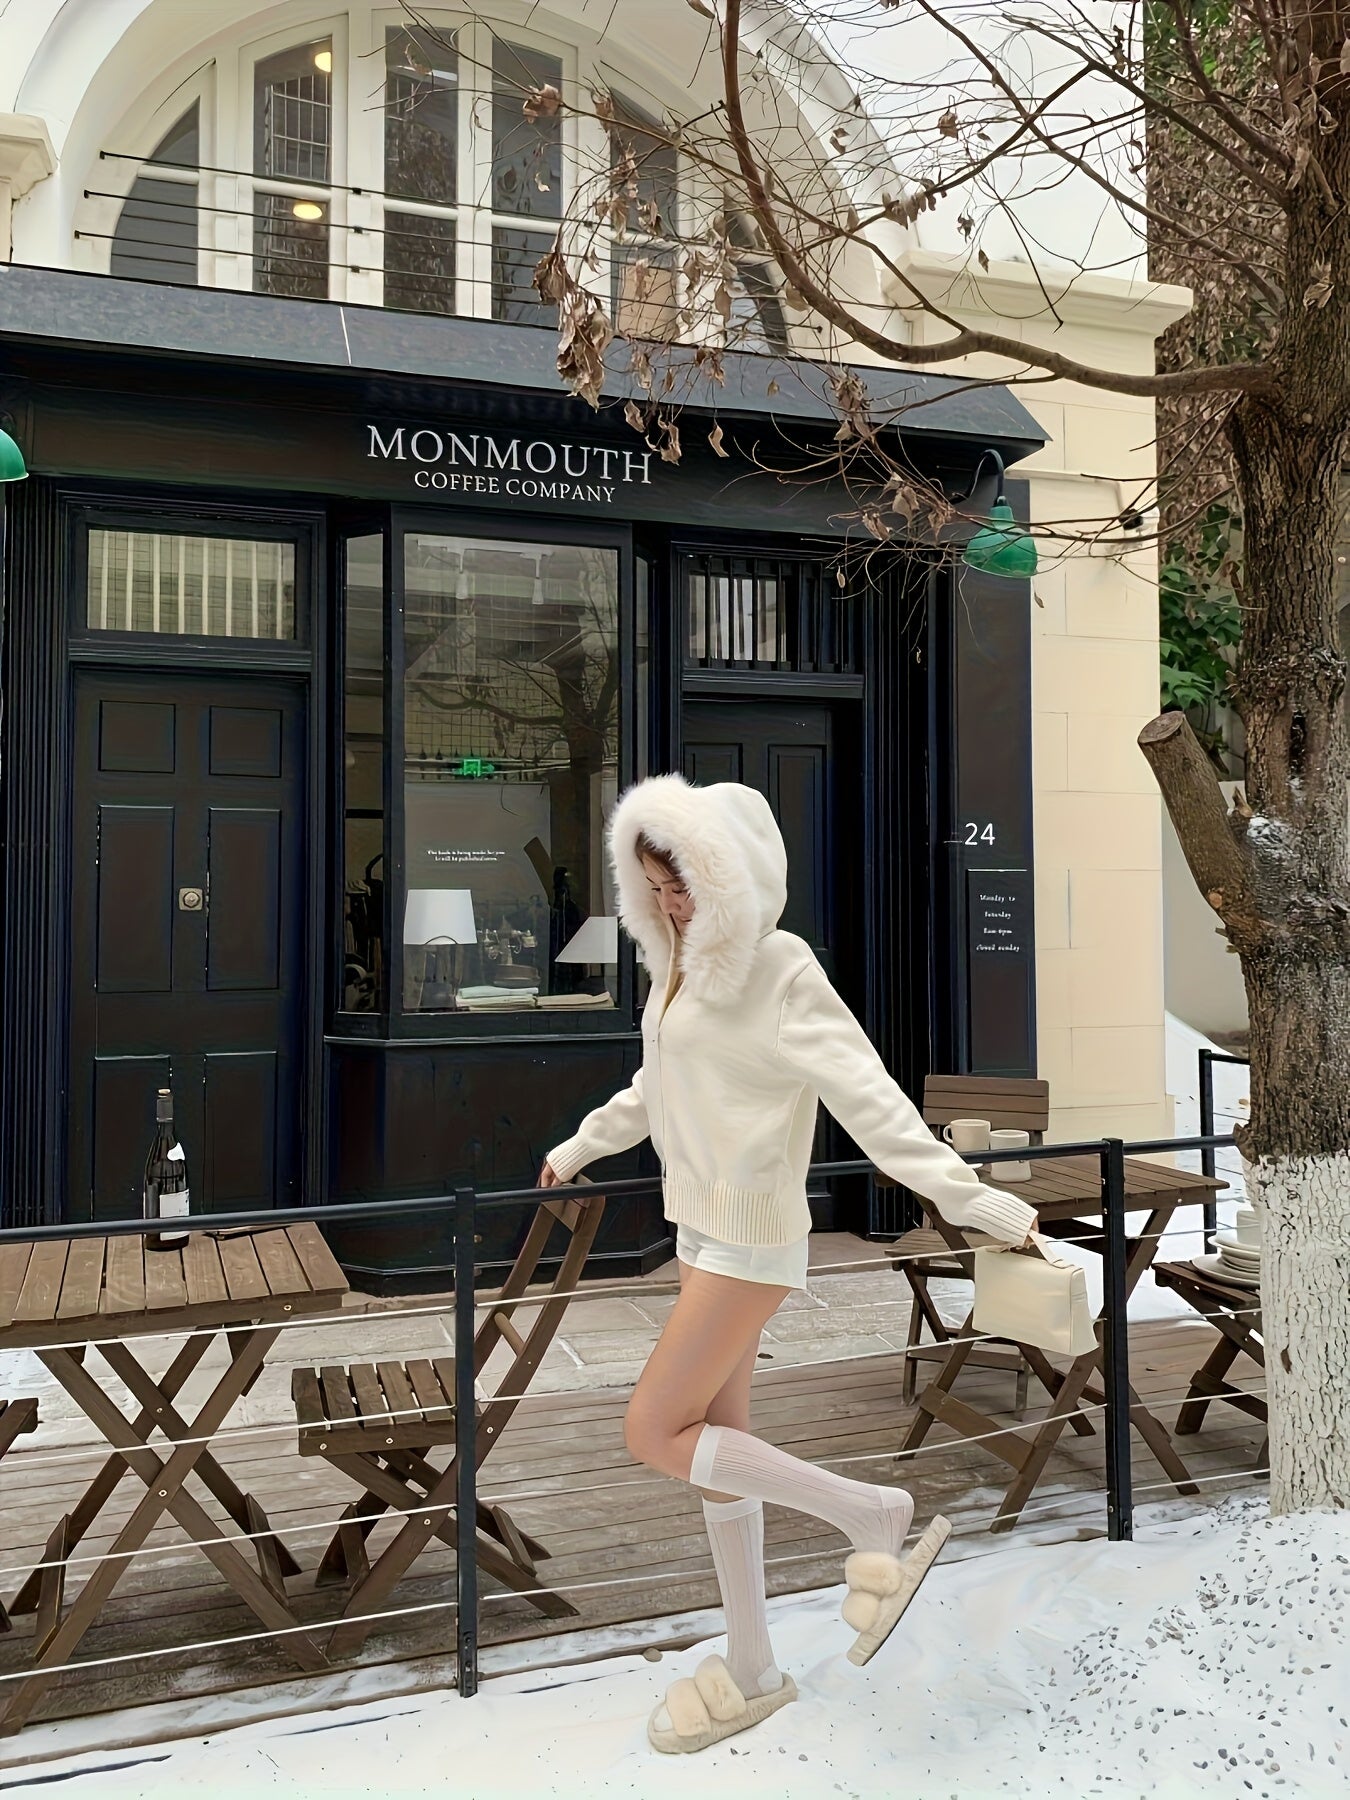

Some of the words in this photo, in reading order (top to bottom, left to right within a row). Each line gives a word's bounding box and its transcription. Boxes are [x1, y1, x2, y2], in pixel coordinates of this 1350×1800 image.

[366, 424, 652, 484] MONMOUTH
[414, 470, 500, 494] COFFEE
[505, 478, 616, 503] COMPANY
[964, 822, 996, 846] 24
